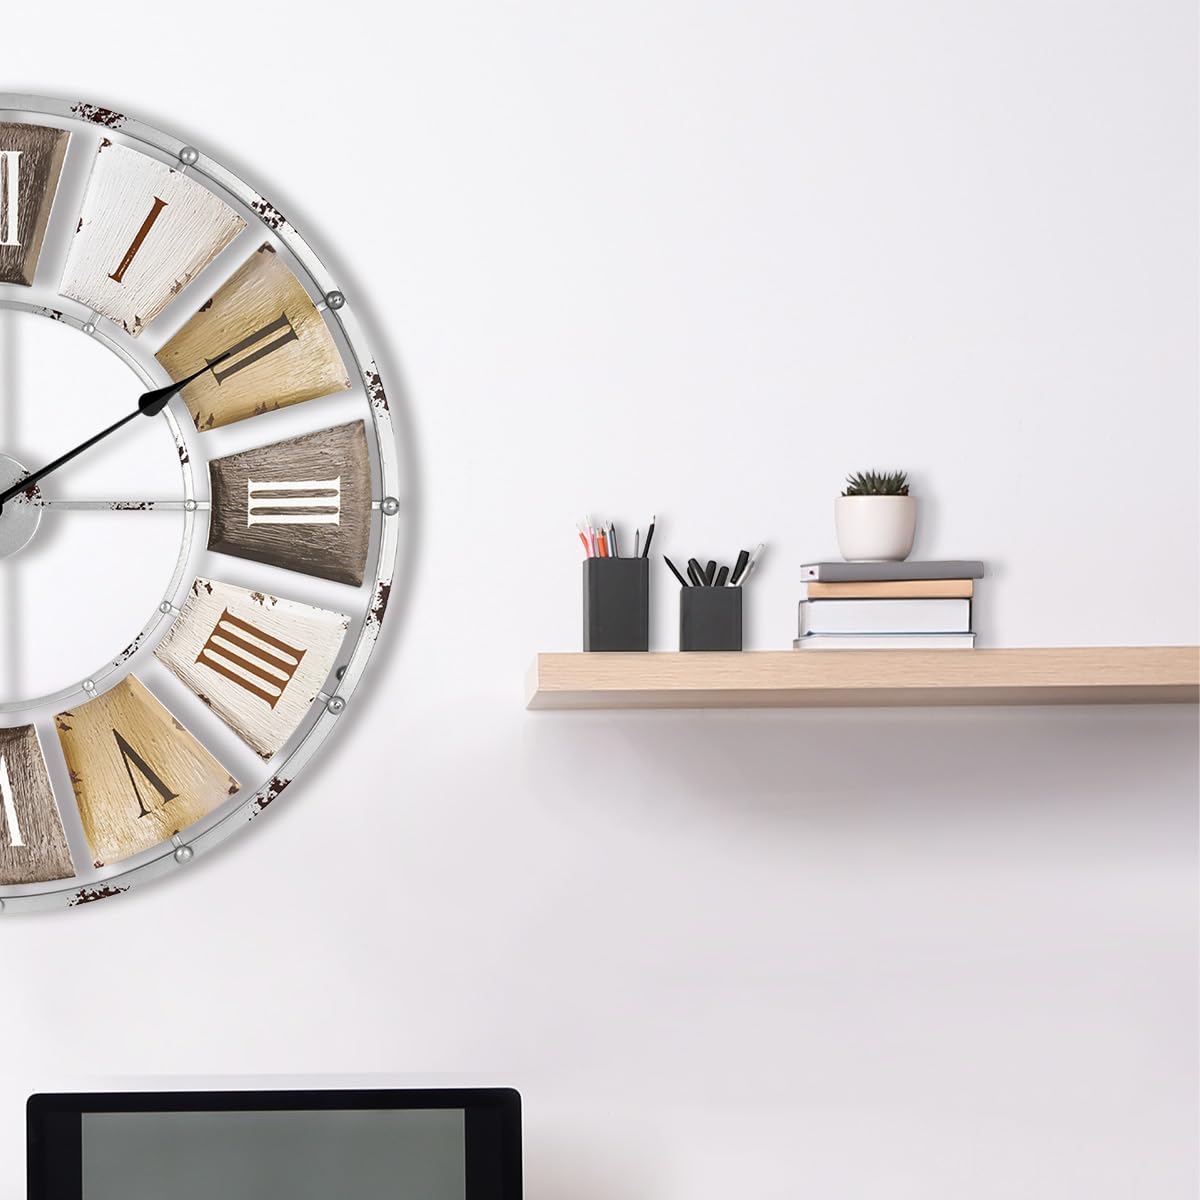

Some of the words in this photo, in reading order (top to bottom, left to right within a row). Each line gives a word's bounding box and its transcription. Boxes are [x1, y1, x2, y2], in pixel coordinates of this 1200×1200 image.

[108, 196, 168, 283] I
[204, 310, 299, 386] II
[247, 475, 340, 528] III
[194, 607, 307, 710] IIII
[112, 728, 180, 819] V
